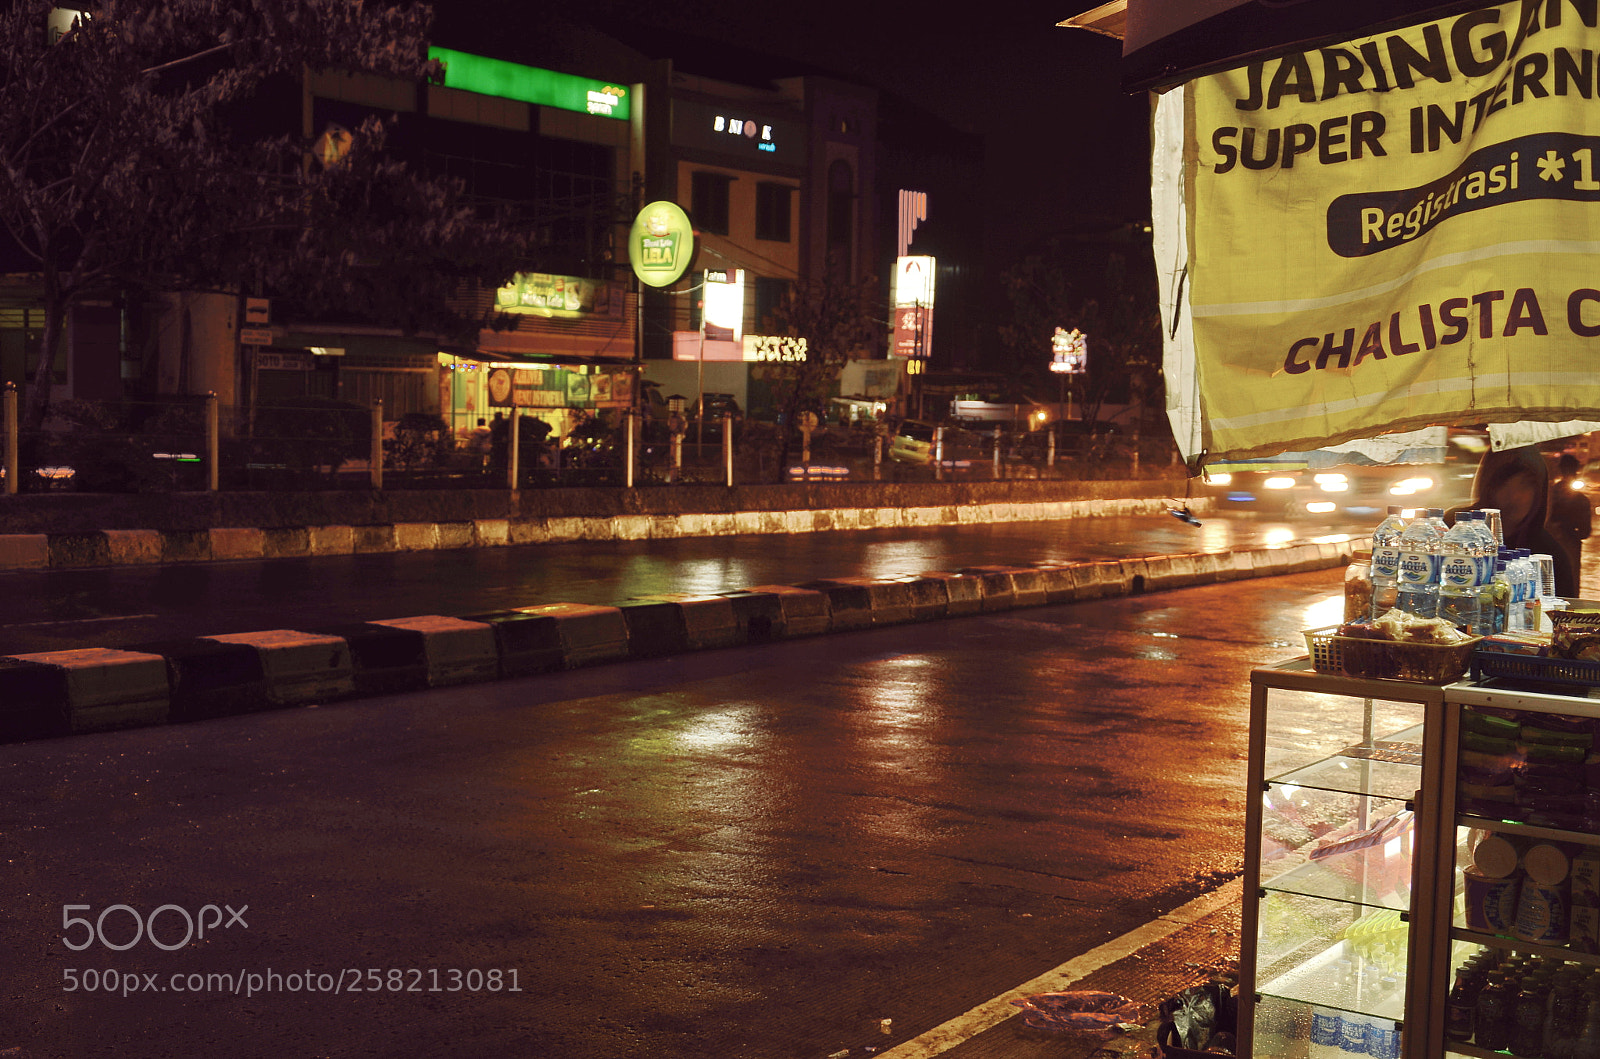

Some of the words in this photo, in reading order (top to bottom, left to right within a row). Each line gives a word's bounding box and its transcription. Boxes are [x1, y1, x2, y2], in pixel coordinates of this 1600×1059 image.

[1212, 110, 1388, 174] SUPER
[1409, 46, 1600, 154] INTERN
[1360, 152, 1519, 244] Registrasi
[1284, 288, 1548, 375] CHALISTA
[1401, 560, 1428, 573] AQUA
[1445, 564, 1474, 577] AQUA
